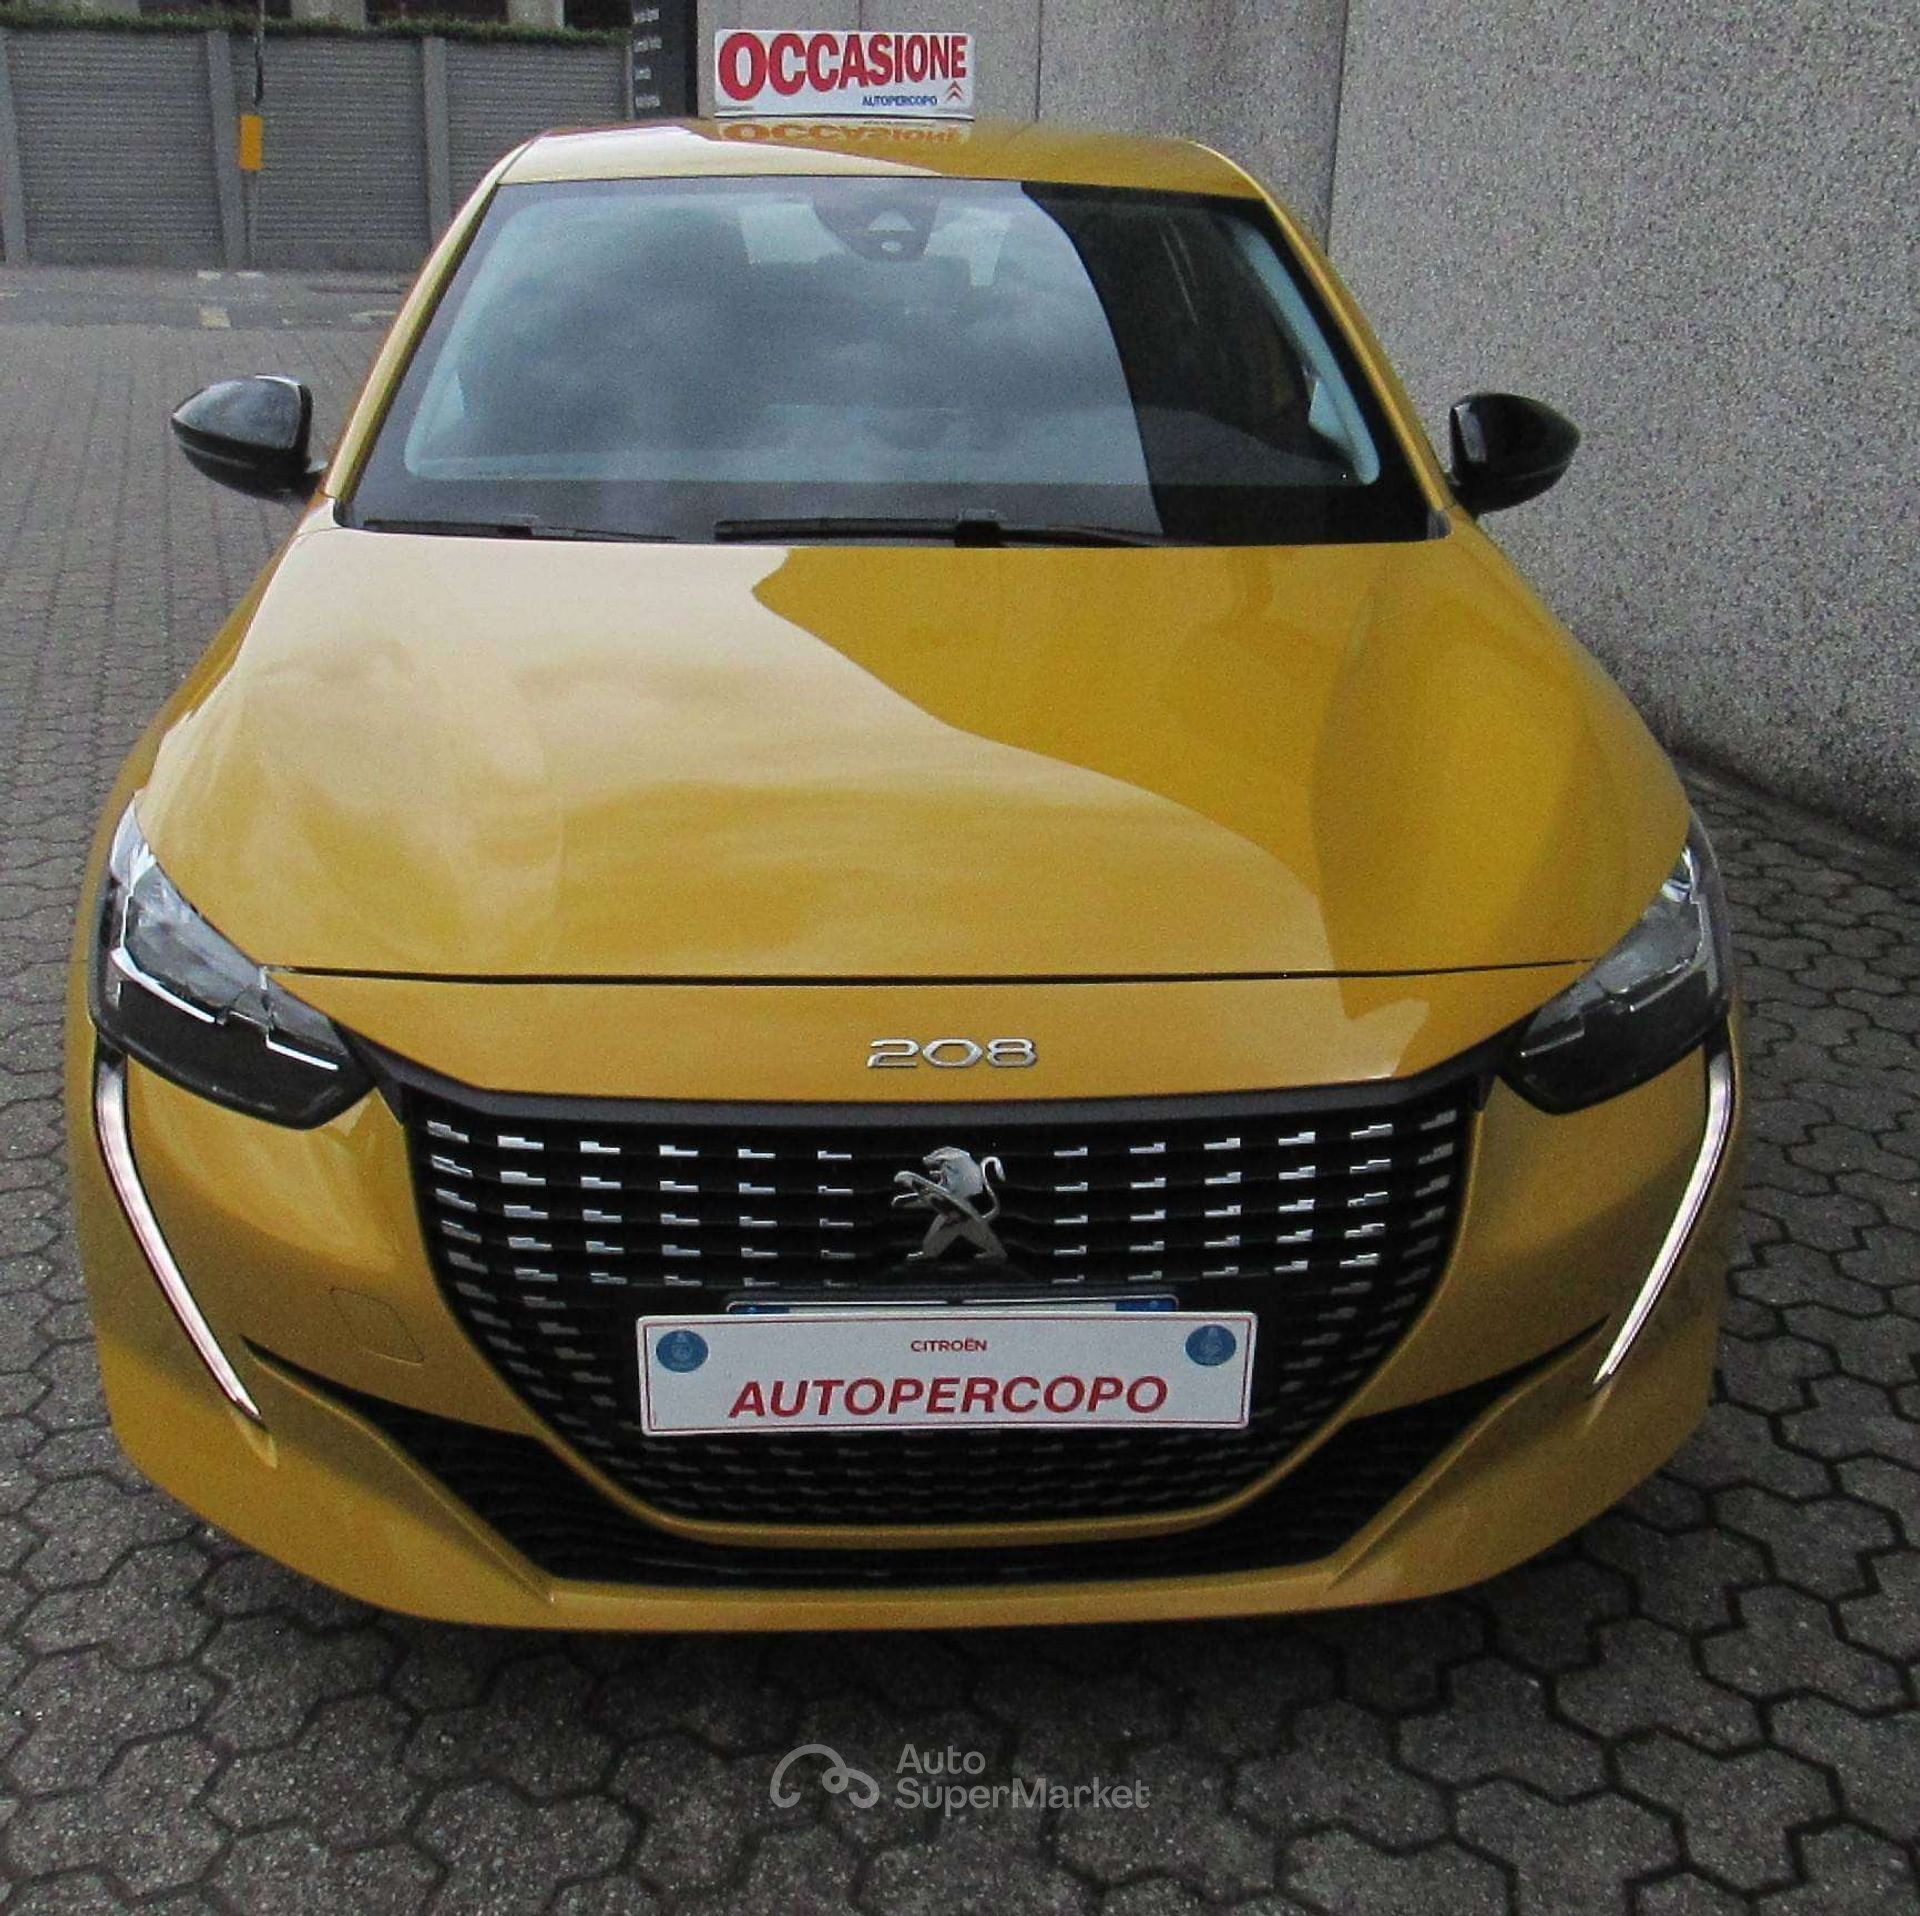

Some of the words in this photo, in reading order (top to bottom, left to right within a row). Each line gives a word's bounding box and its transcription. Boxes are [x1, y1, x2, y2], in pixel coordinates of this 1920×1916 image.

[718, 32, 967, 101] OCCASIONE
[862, 95, 938, 107] AUTOPERCOPO
[867, 1038, 1037, 1068] 208
[911, 1338, 987, 1352] CITROËN
[728, 1375, 1168, 1418] AUTOPERCOPO
